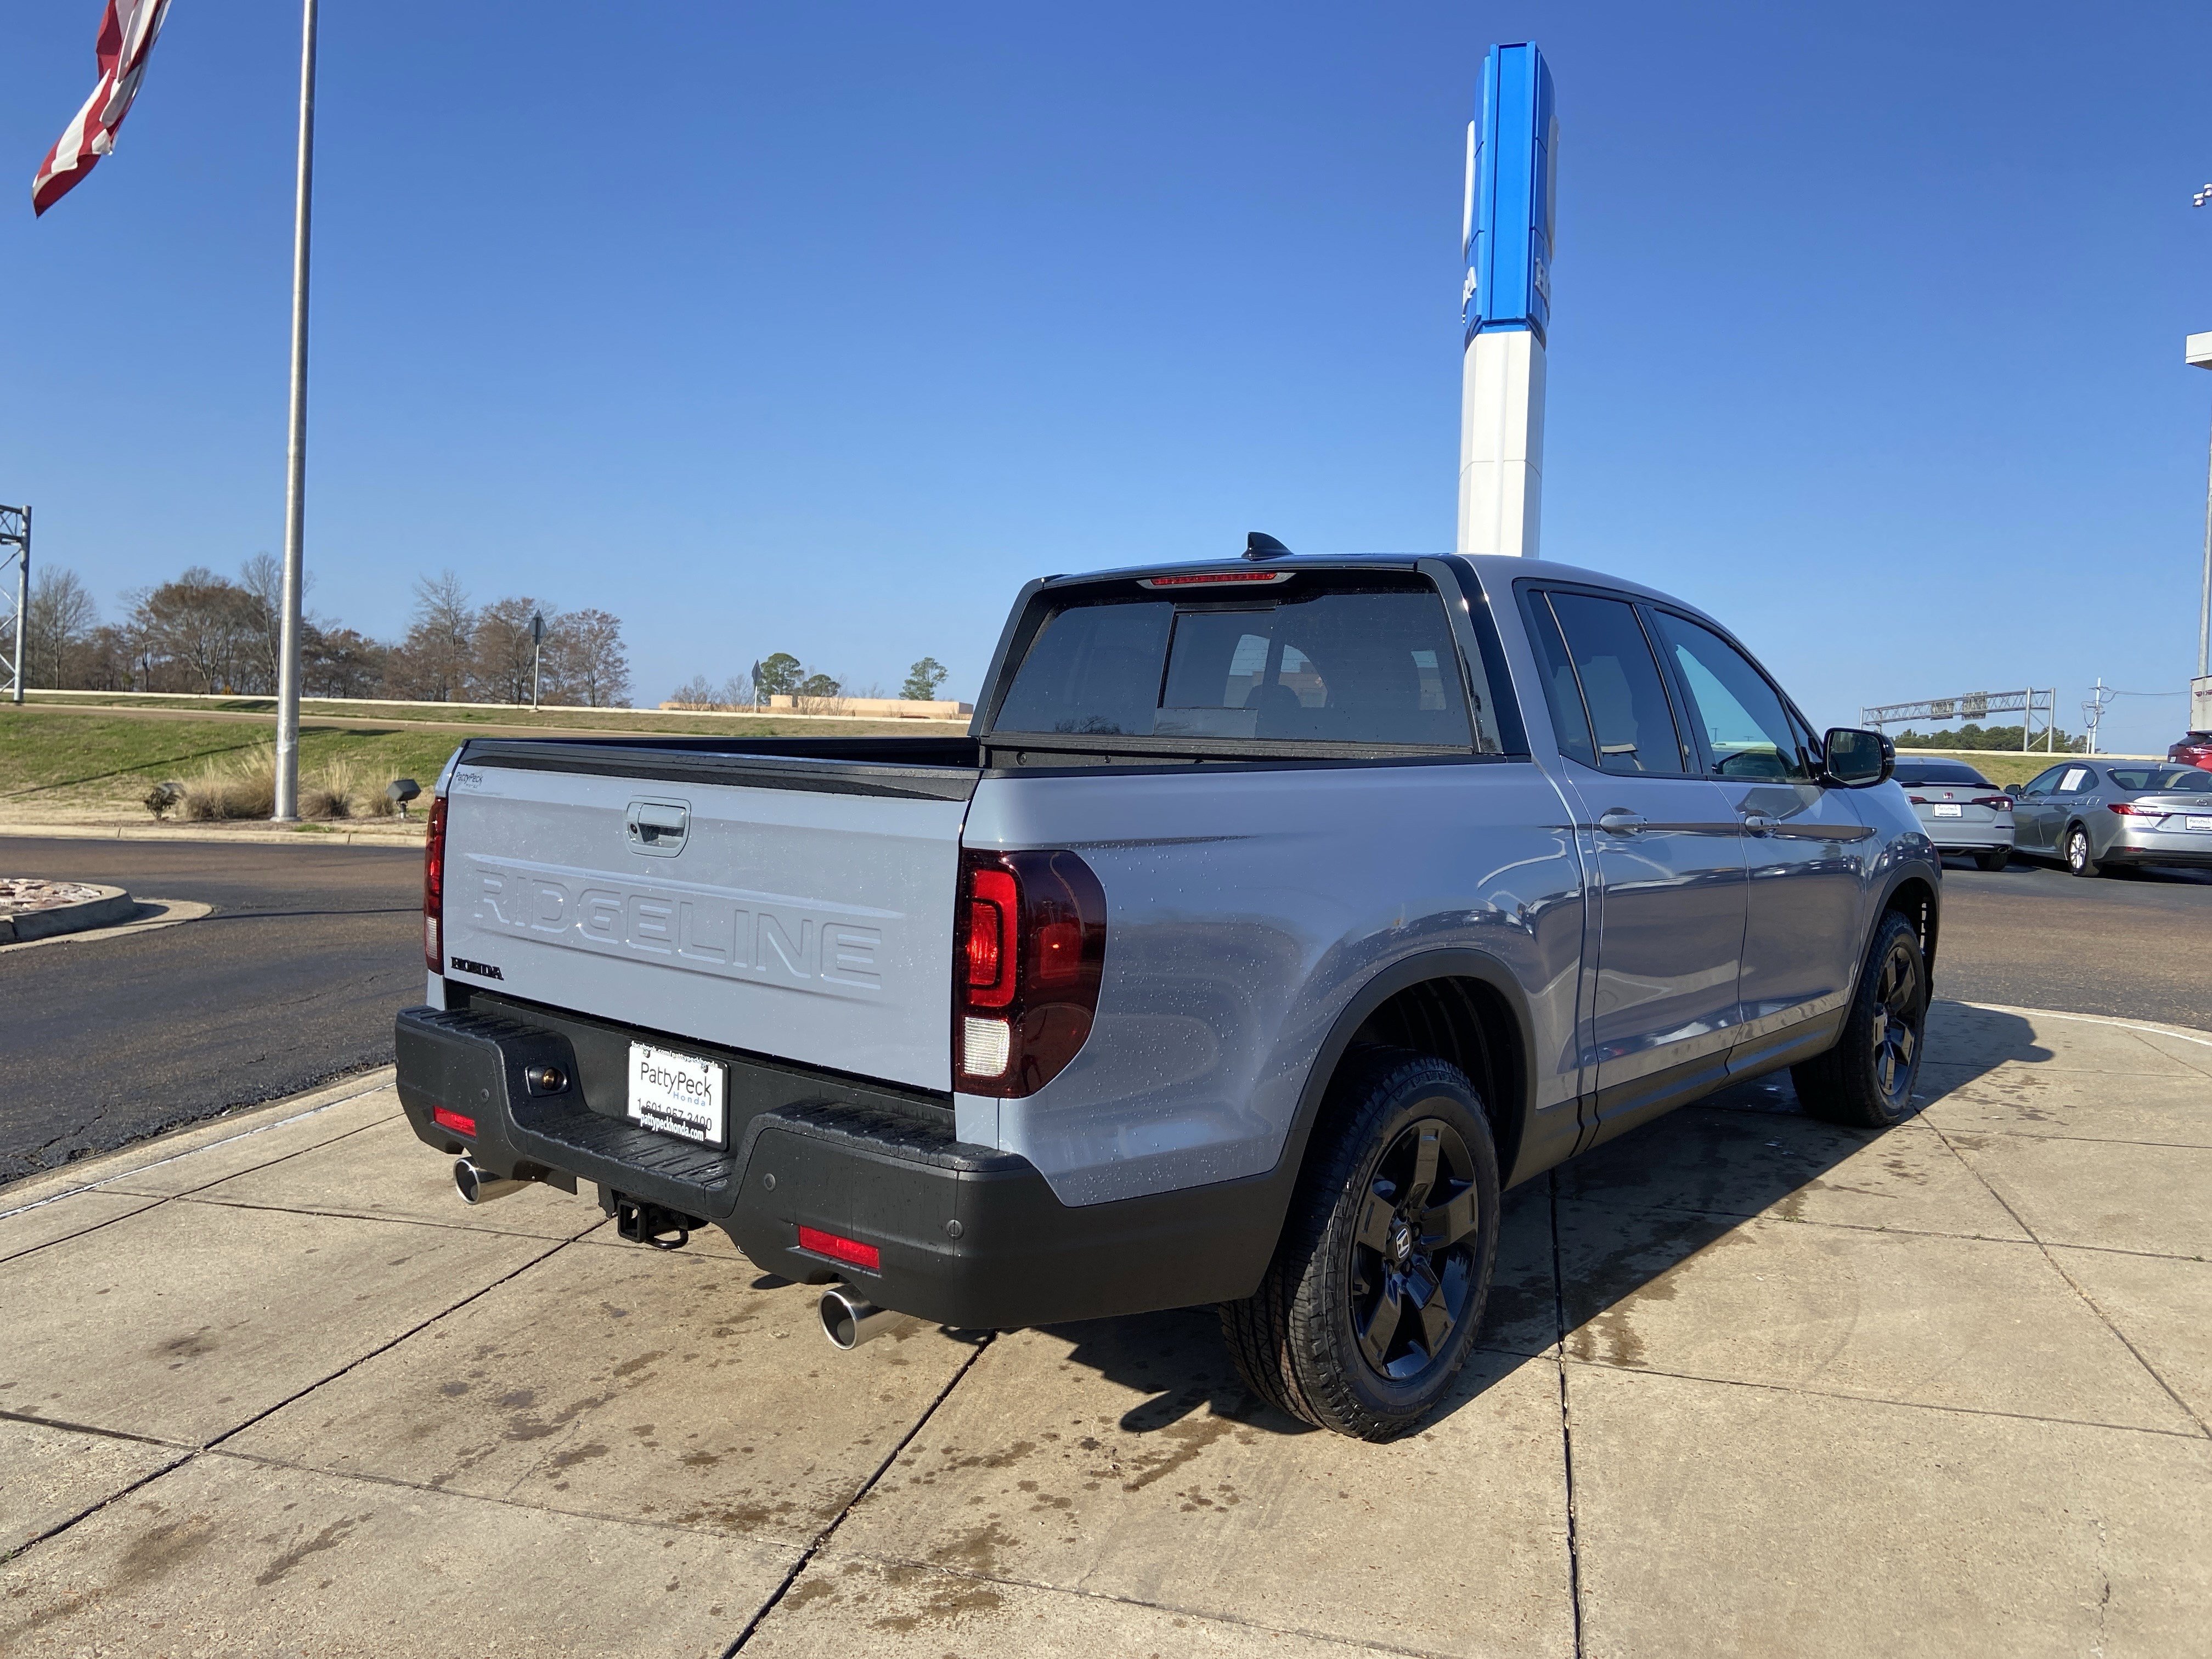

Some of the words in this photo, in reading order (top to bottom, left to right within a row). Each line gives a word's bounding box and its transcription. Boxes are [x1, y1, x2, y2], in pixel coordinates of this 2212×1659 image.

[475, 870, 881, 989] RIDGELINE
[450, 956, 504, 980] HONDA
[641, 1061, 712, 1105] PattyPeck
[673, 1091, 706, 1107] Honda
[640, 1113, 704, 1142] pattypeckhonda.com
